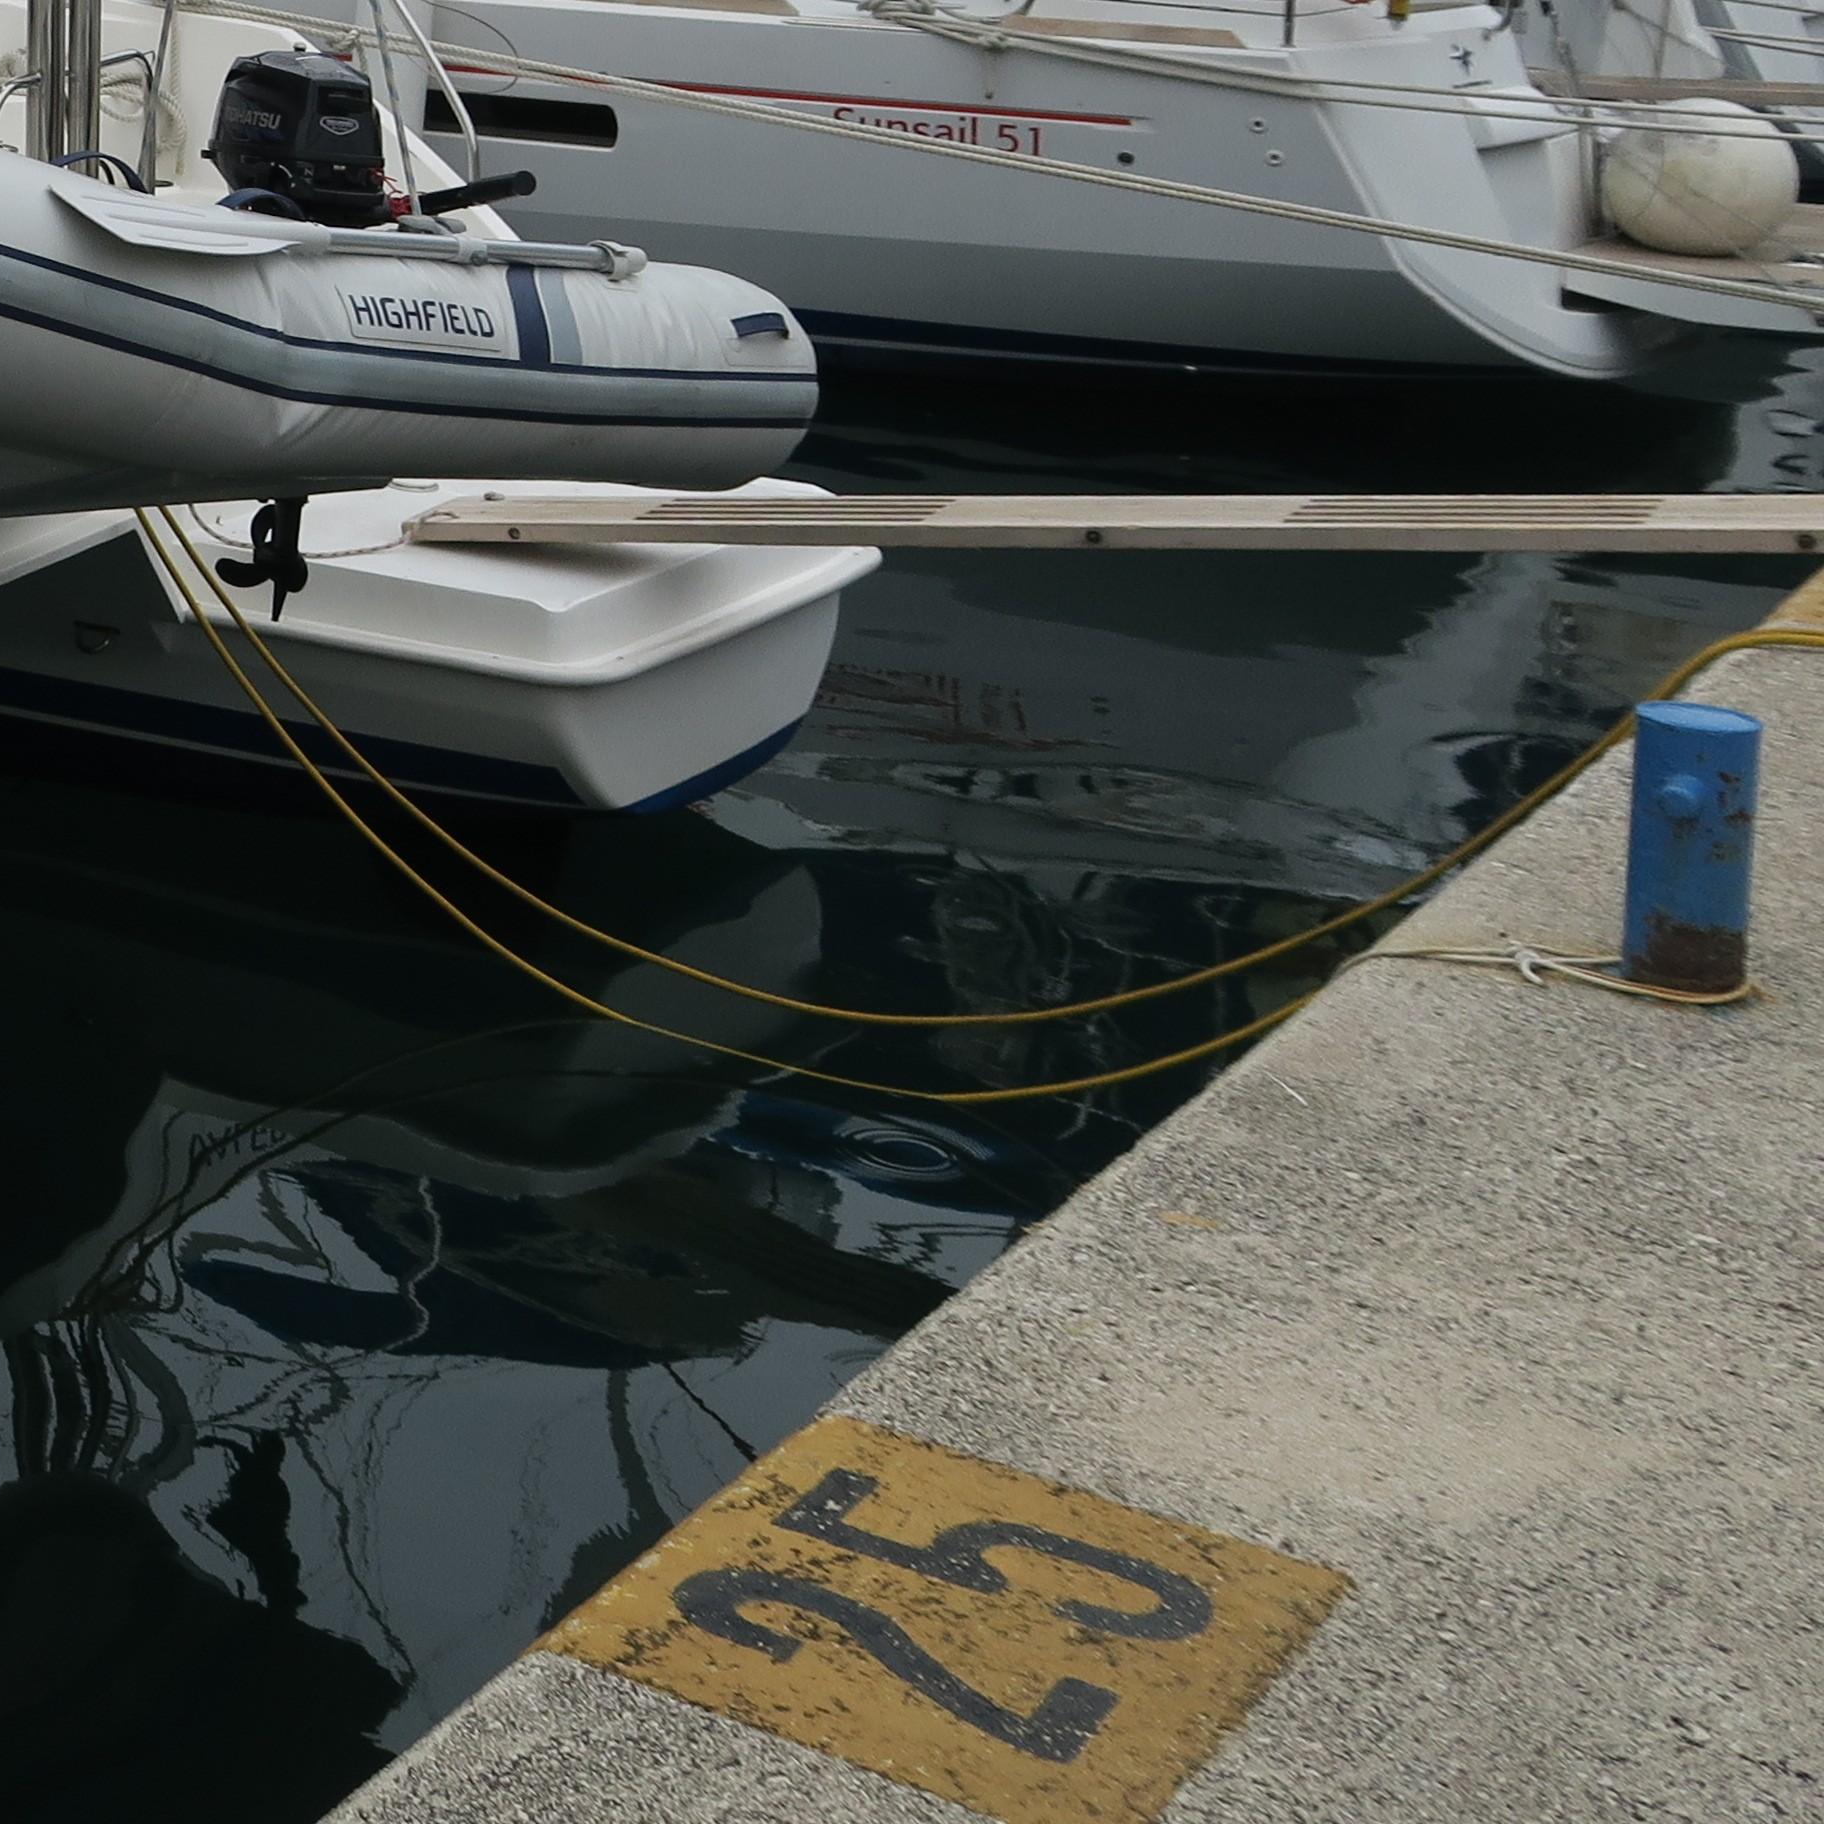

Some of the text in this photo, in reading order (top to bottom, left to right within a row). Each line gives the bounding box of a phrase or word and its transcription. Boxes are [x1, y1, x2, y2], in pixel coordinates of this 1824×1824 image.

[833, 106, 1043, 157] Snsail 51
[347, 293, 495, 339] HIGHFIELD
[673, 1467, 1213, 1764] 25
